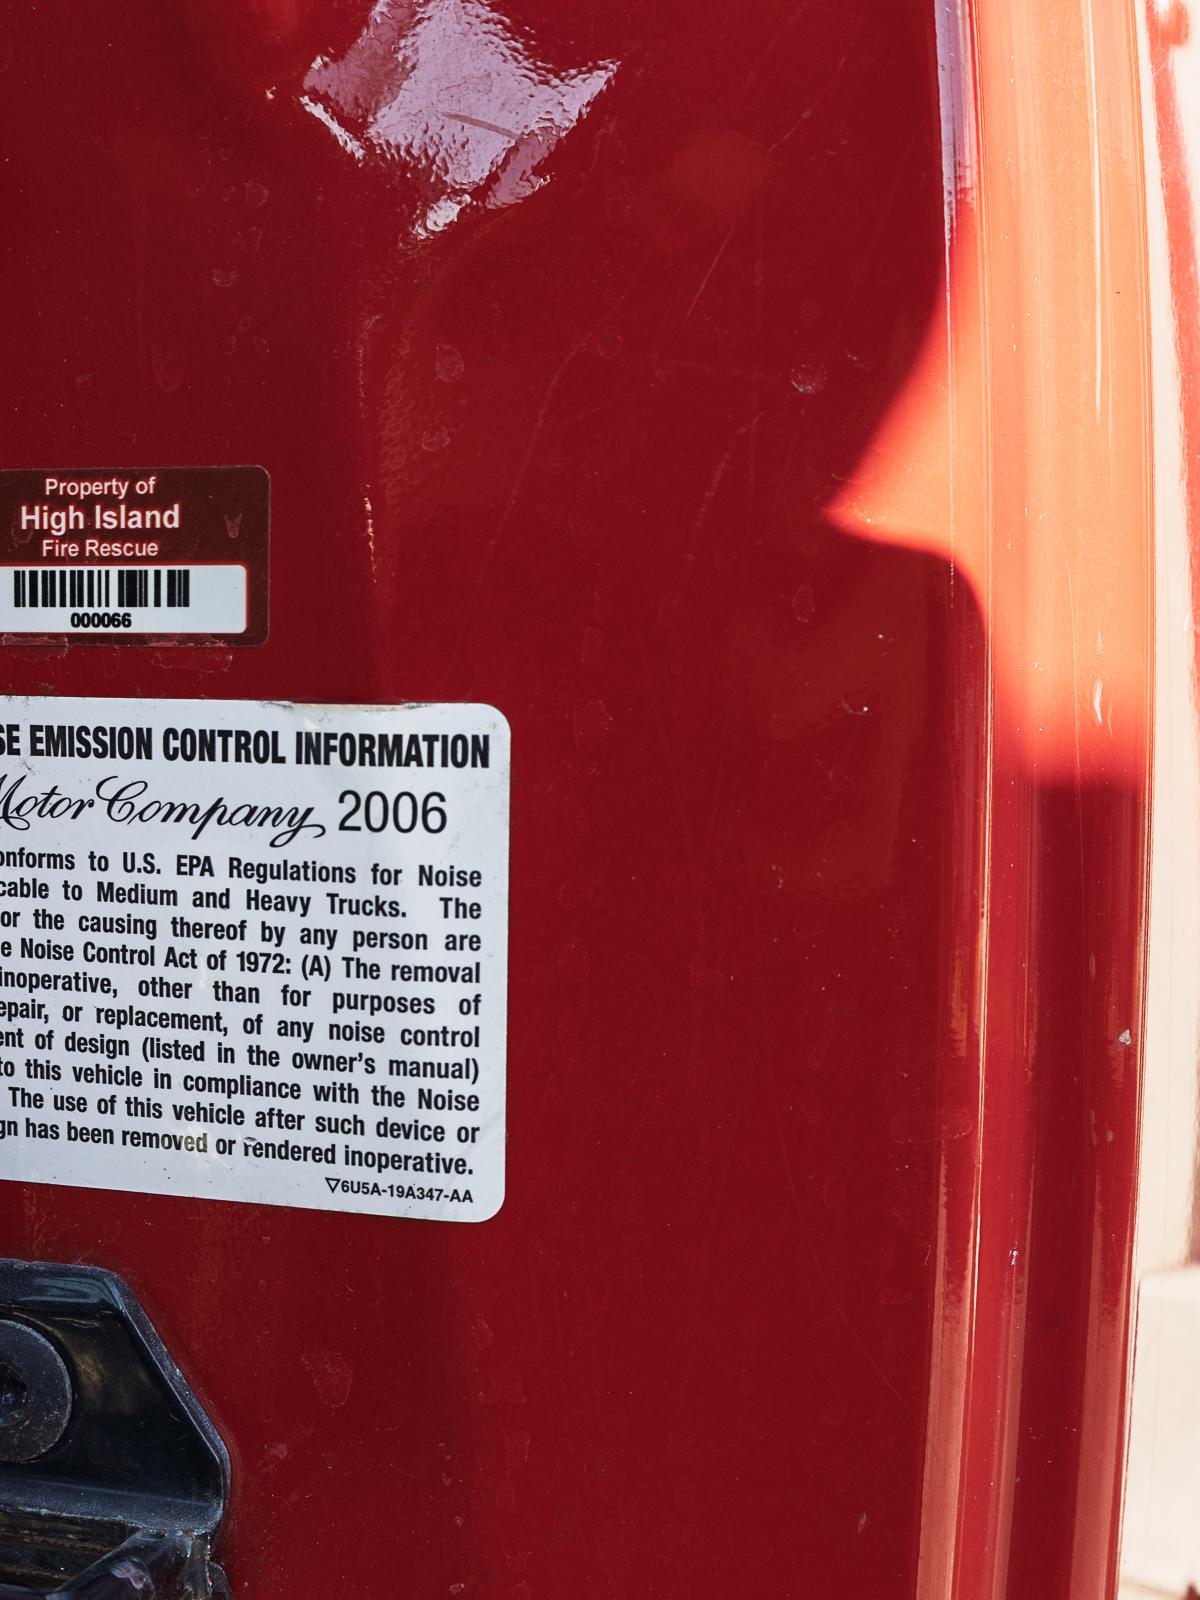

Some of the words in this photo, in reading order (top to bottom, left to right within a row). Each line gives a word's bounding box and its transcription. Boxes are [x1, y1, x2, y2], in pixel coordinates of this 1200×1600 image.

[45, 477, 128, 499] Property
[136, 476, 156, 494] of
[21, 505, 84, 535] High
[95, 504, 180, 529] Island
[42, 539, 79, 557] Fire
[85, 539, 159, 557] Rescue
[70, 612, 132, 628] 000066
[29, 724, 152, 760] EMISSION
[162, 727, 286, 764] CONTROL
[295, 731, 490, 768] INFORMATION
[95, 776, 326, 848] Company
[337, 790, 448, 834] 2006
[88, 851, 109, 871] to
[123, 852, 160, 874] U.S.
[177, 855, 214, 877] EPA
[229, 857, 356, 884] Regulations
[371, 863, 402, 885] for
[419, 865, 481, 887] Noise
[62, 880, 82, 901] to
[97, 881, 177, 906] Medium
[193, 888, 230, 909] and
[247, 889, 311, 917] Heavy
[326, 893, 406, 917] Trucks.
[440, 897, 481, 919] The
[1, 911, 20, 927] or
[33, 909, 64, 930] the
[79, 914, 156, 940] causing
[171, 917, 247, 941] thereof
[261, 921, 285, 947] by
[300, 928, 337, 950] any
[353, 931, 427, 952] person
[445, 934, 481, 951] are
[21, 938, 74, 961] Noise
[83, 942, 154, 966] Control
[164, 947, 197, 969] Act
[207, 950, 226, 970] of
[237, 951, 290, 974] 1972:
[302, 955, 331, 982] (A)
[342, 957, 380, 979] The
[392, 962, 480, 983] removal
[138, 977, 192, 999] other
[213, 981, 259, 1003] than
[281, 984, 311, 1007] for
[333, 993, 435, 1016] purposes
[459, 994, 481, 1015] of
[62, 1005, 83, 1022] or
[96, 1005, 227, 1036] replacement,
[243, 1014, 263, 1035] of
[277, 1020, 314, 1043] any
[329, 1021, 384, 1043] noise
[401, 1026, 479, 1047] control
[35, 1030, 54, 1050] of
[65, 1032, 129, 1059] design
[142, 1037, 204, 1062] (listed
[218, 1042, 235, 1064] in
[247, 1045, 280, 1067] the
[292, 1053, 375, 1074] owner's
[389, 1058, 479, 1084] manual)
[25, 1059, 61, 1081] this
[72, 1064, 142, 1087] vehicle
[154, 1068, 171, 1089] in
[183, 1075, 301, 1099] compliance
[313, 1082, 359, 1104] with
[371, 1085, 405, 1108] the
[418, 1088, 479, 1111] Noise
[8, 1087, 44, 1109] The
[54, 1095, 87, 1112] use
[97, 1095, 116, 1115] of
[125, 1097, 162, 1119] this
[172, 1102, 244, 1125] vehicle
[255, 1108, 305, 1130] after
[315, 1115, 364, 1136] such
[376, 1117, 445, 1142] device
[457, 1127, 480, 1143] or
[26, 1118, 59, 1140] has
[67, 1121, 114, 1144] been
[122, 1130, 207, 1153] removed
[216, 1139, 236, 1155] or
[244, 1137, 335, 1164] rendered
[345, 1145, 473, 1174] inoperative.
